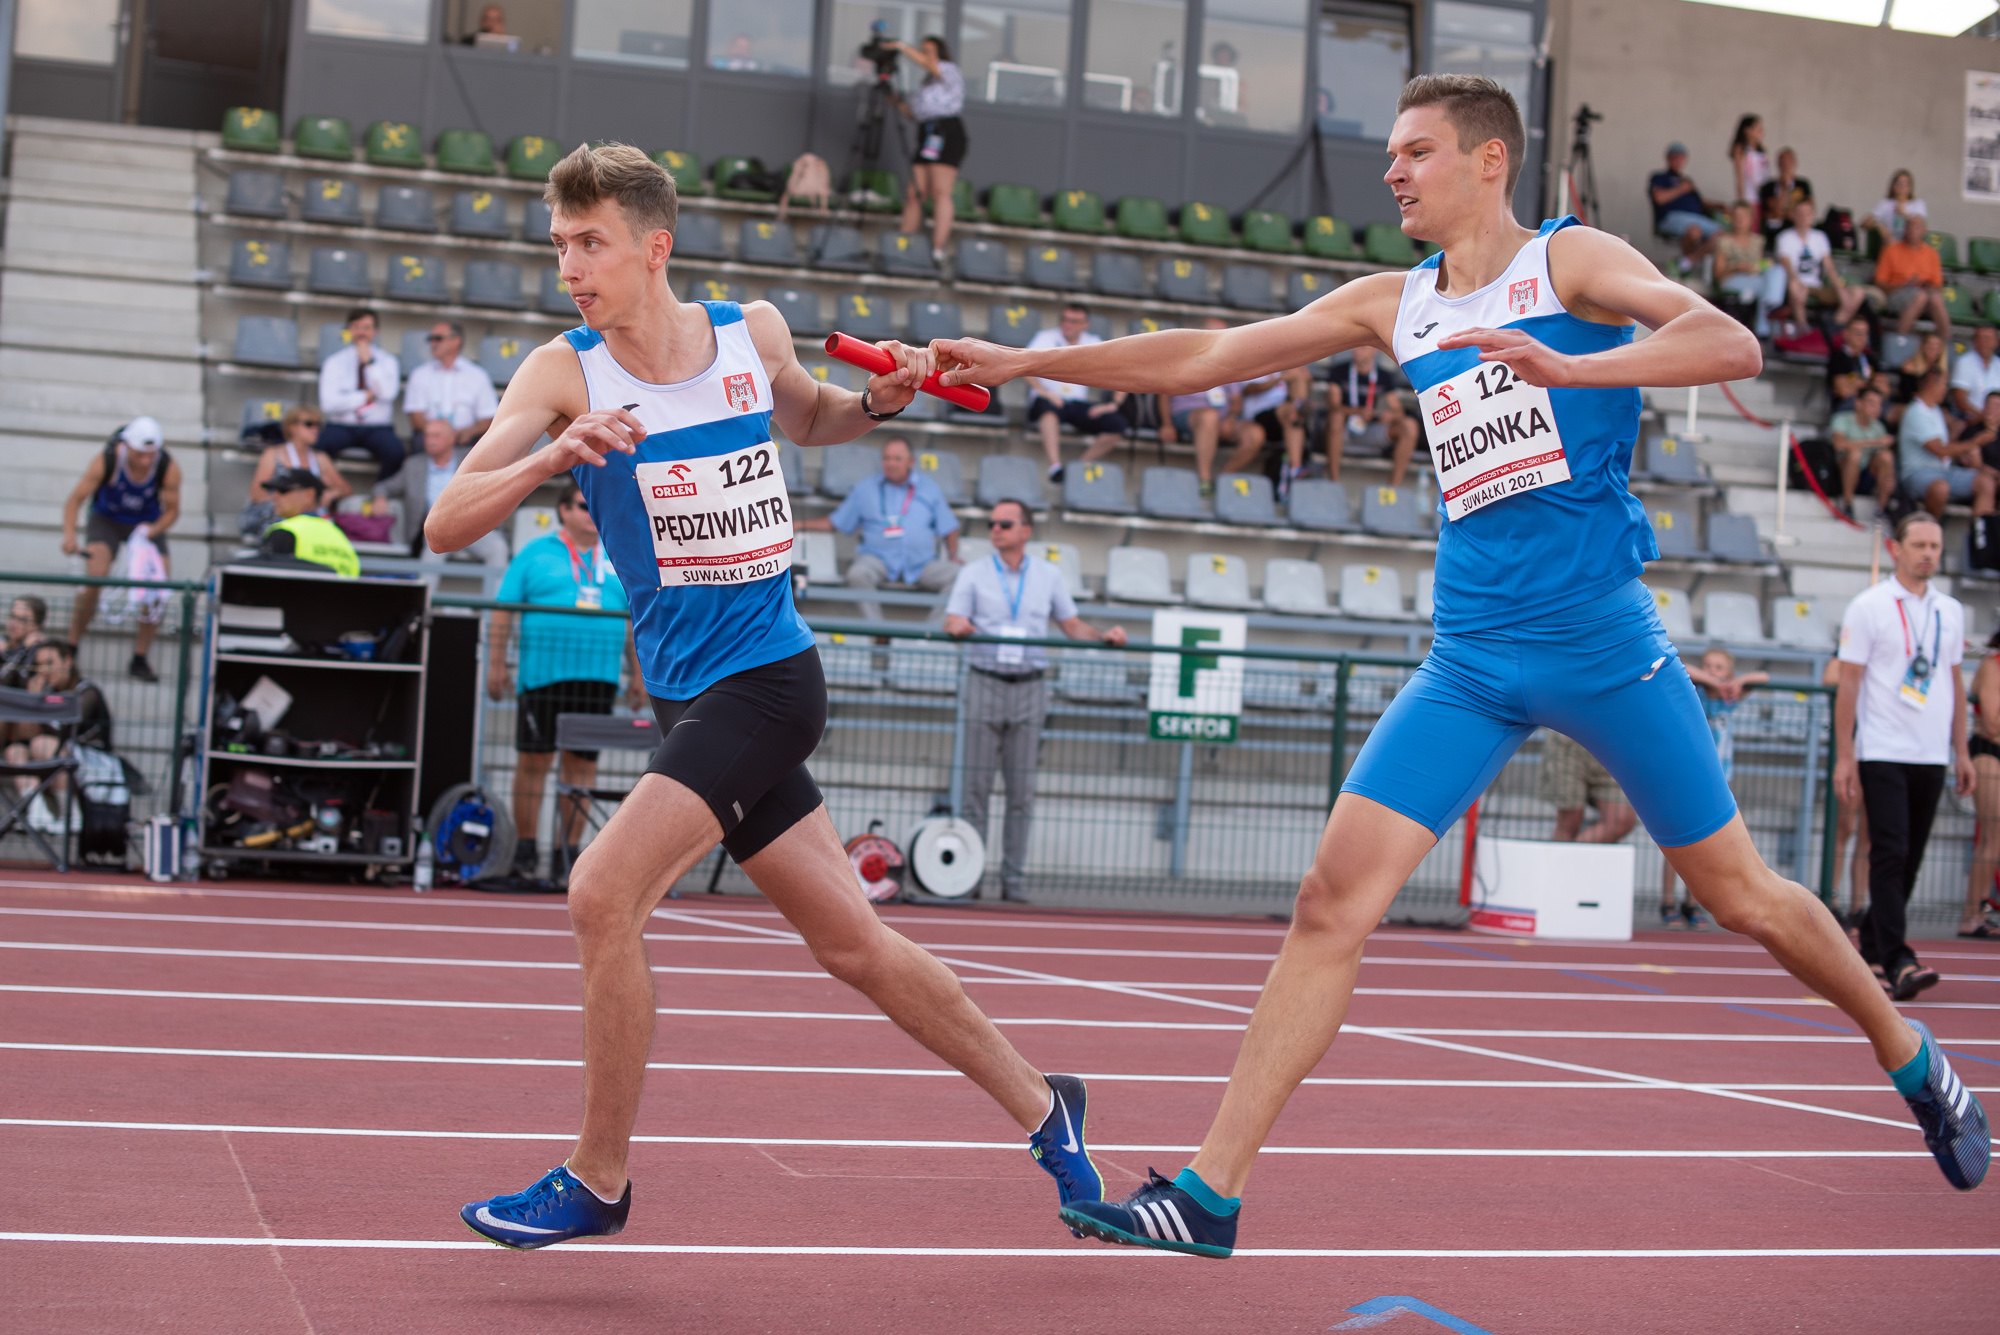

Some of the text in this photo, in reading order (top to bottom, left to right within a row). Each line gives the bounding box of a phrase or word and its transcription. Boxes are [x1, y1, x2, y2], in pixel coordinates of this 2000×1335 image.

[1434, 402, 1460, 424] ORLEN
[1436, 407, 1551, 473] ZIELONKA
[718, 449, 774, 489] 122
[1511, 458, 1541, 471] POLSKI
[1541, 452, 1560, 462] U23
[654, 484, 695, 497] ORLEN
[1462, 470, 1544, 512] SUWAŁKI 2021
[653, 496, 788, 546] PĘDZIWIATR
[696, 554, 751, 565] MISTRZOSTWA
[751, 547, 778, 558] POLSKI
[778, 542, 791, 551] U23
[682, 559, 780, 583] SUWAŁKI 2021
[1178, 626, 1221, 697] F
[1157, 715, 1231, 739] SEKTOR
